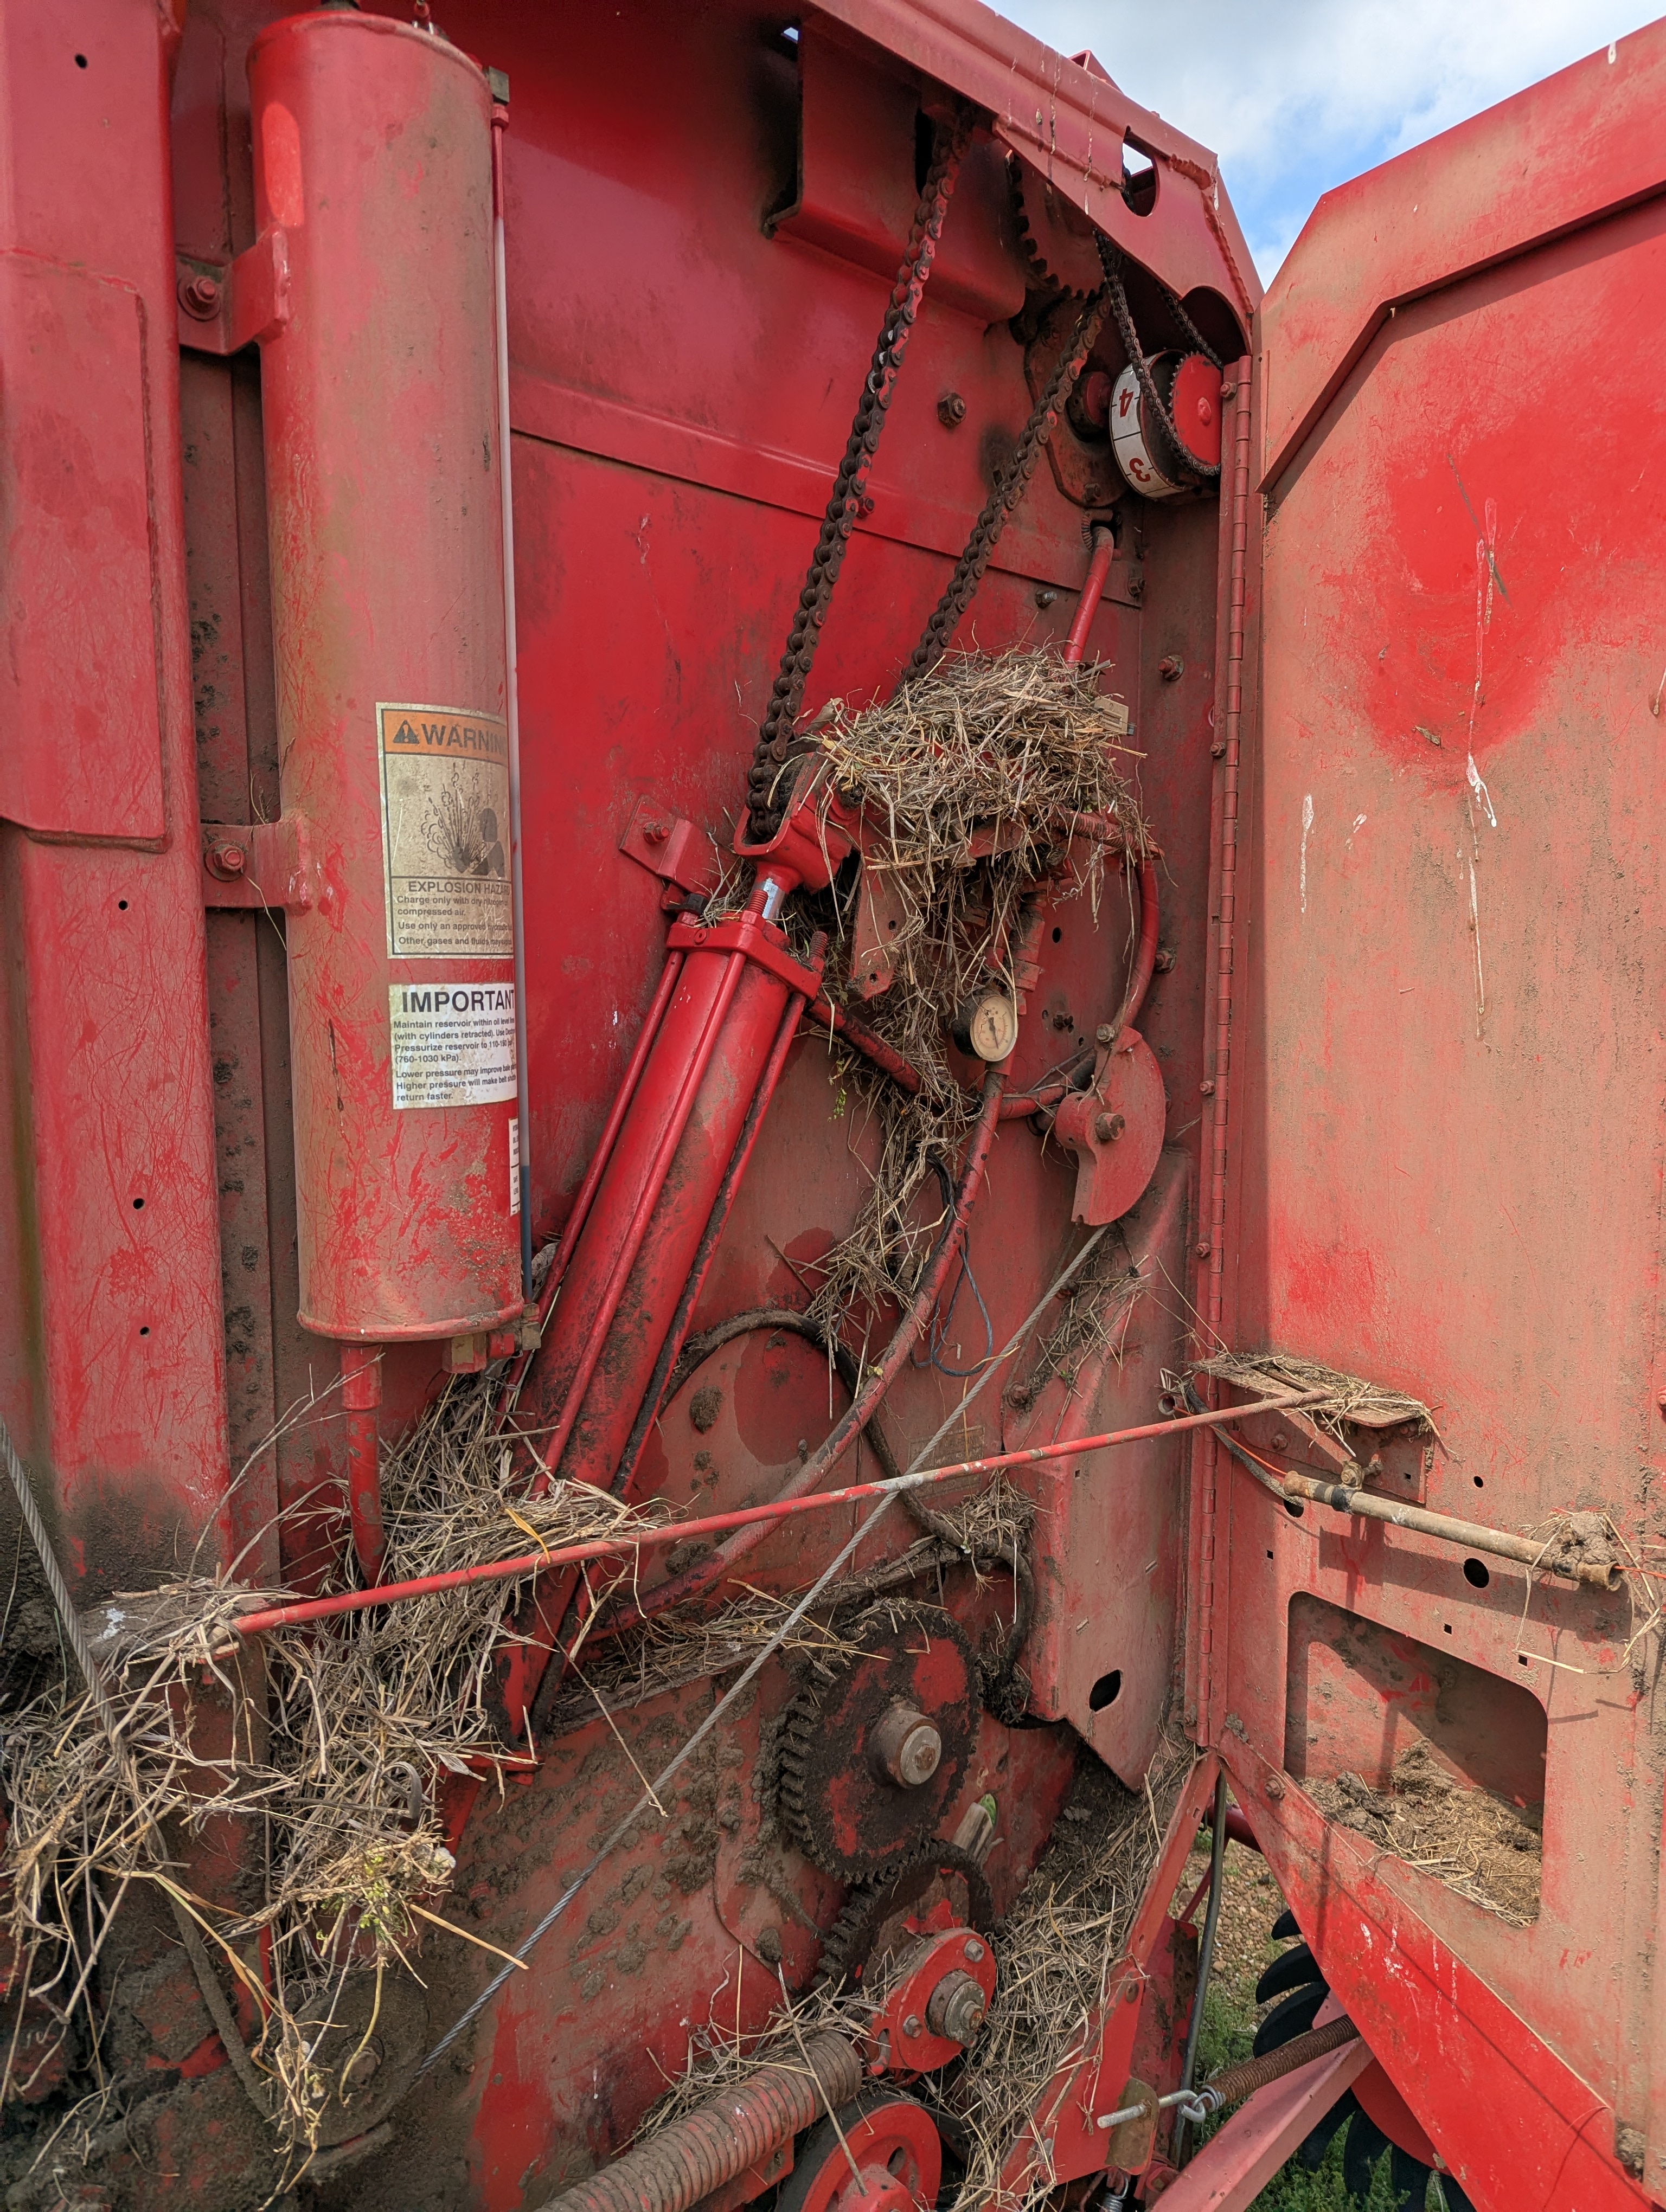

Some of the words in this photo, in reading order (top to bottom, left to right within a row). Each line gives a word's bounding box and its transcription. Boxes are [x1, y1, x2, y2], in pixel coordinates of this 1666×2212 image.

[1119, 388, 1134, 418] 4
[1129, 458, 1151, 483] 3
[408, 881, 481, 894] EXPLOSION
[397, 895, 430, 905] Charge
[432, 896, 451, 906] only
[453, 896, 469, 904] with
[471, 897, 482, 907] dry
[397, 908, 452, 917] compressed
[454, 908, 466, 916] air.
[398, 921, 416, 929] Use
[418, 922, 438, 931] only
[453, 923, 486, 932] approved
[399, 936, 425, 944] Other
[427, 938, 453, 947] gases
[393, 1020, 432, 1029] Maintain
[435, 1019, 471, 1028] reservoir
[473, 1018, 492, 1027] within
[394, 1032, 416, 1041] (with
[419, 1032, 459, 1041] cylinders
[461, 1029, 495, 1039] retracted).
[394, 1043, 443, 1052] Pressurize
[445, 1041, 479, 1051] reservoir
[480, 1041, 488, 1049] to
[489, 1039, 507, 1049] 110-150
[395, 1054, 439, 1065] (760-1030
[441, 1053, 462, 1063] kPa).
[396, 1070, 424, 1078] Lower
[425, 1069, 462, 1079] pressure
[464, 1068, 479, 1077] may
[480, 1066, 502, 1076] improve
[396, 1082, 427, 1091] Higher
[429, 1081, 466, 1090] pressure
[468, 1078, 480, 1086] will
[482, 1077, 498, 1086] make
[427, 1092, 453, 1101] faster.
